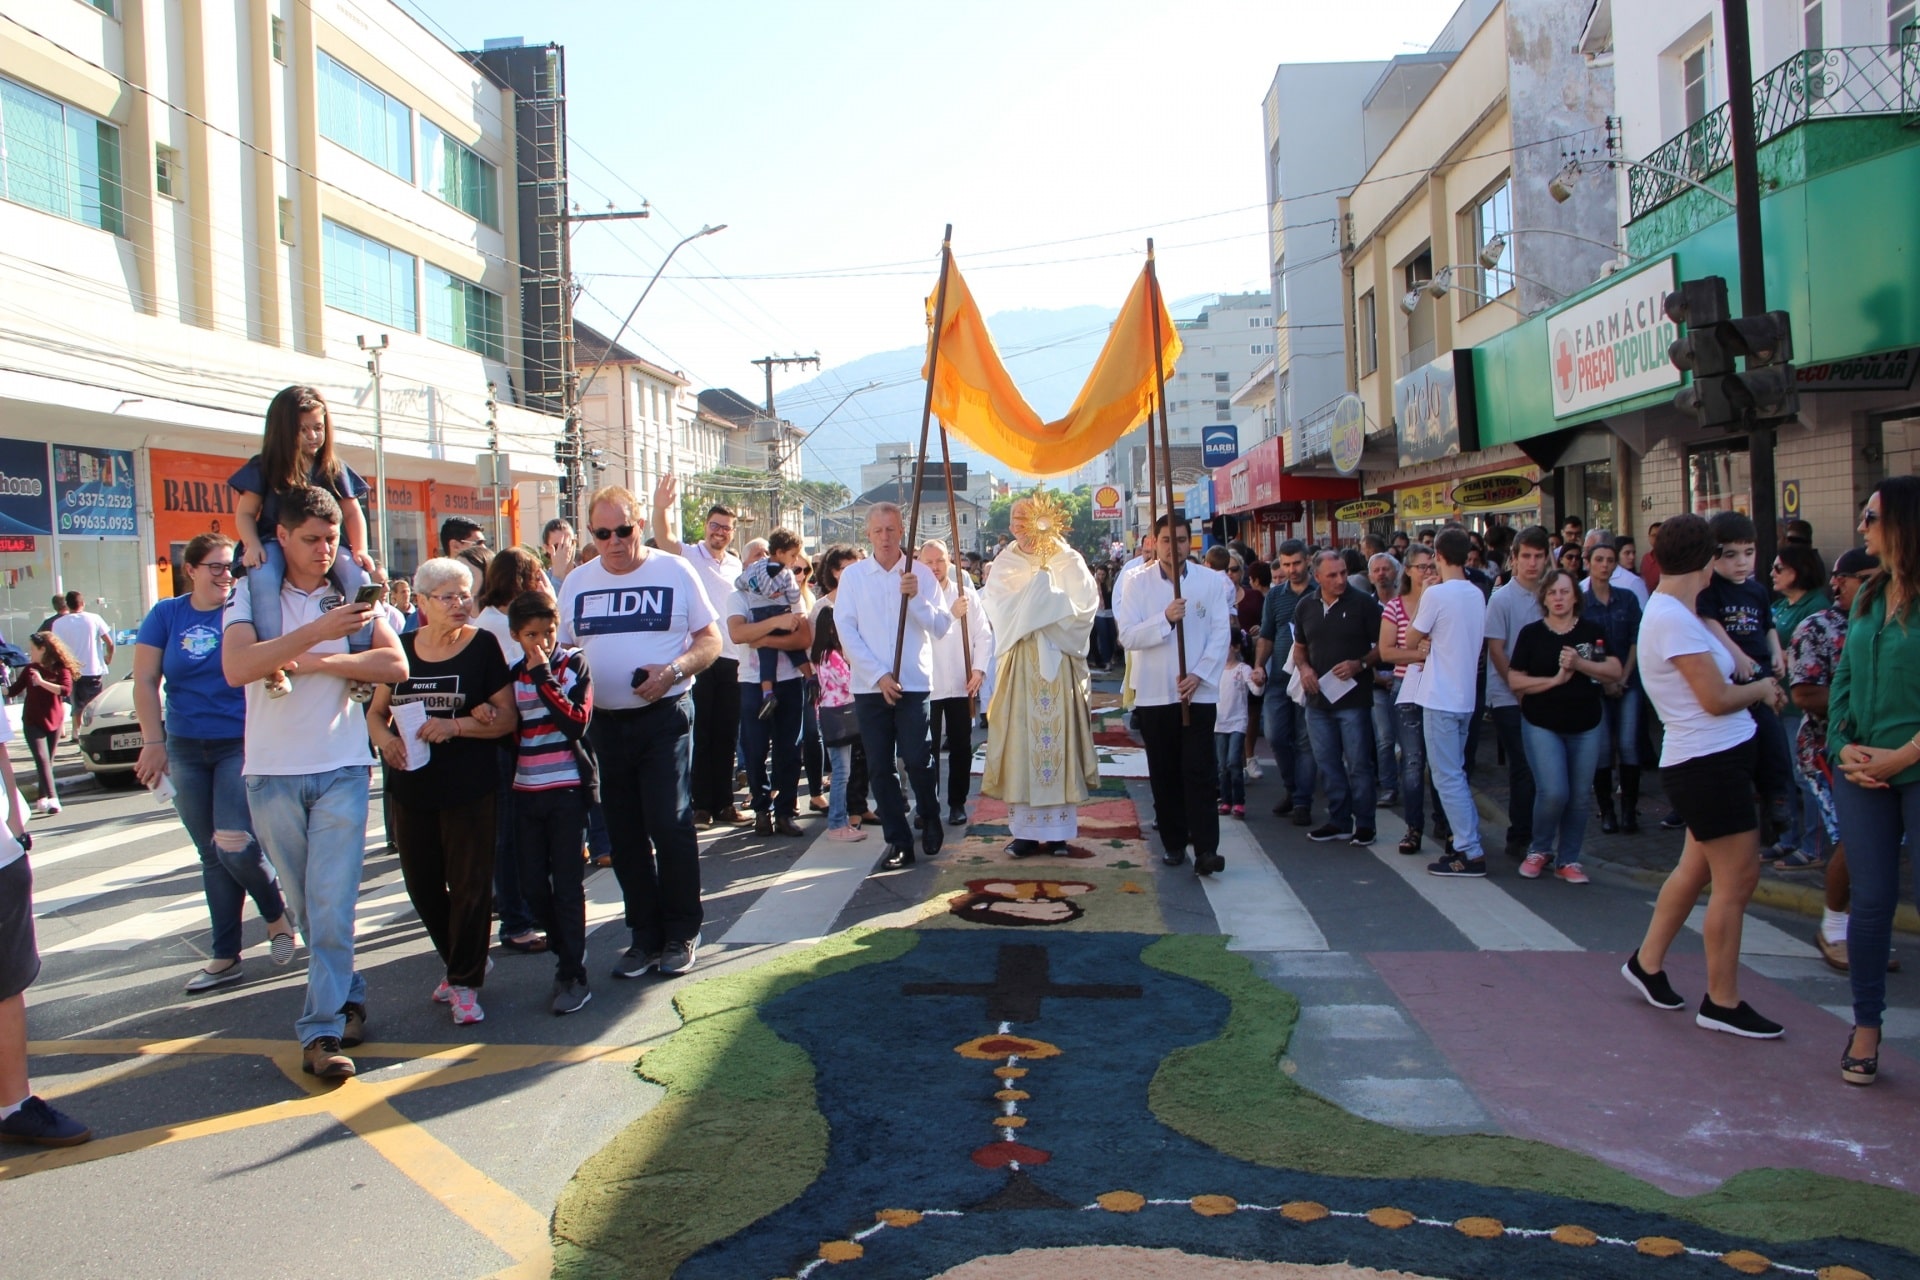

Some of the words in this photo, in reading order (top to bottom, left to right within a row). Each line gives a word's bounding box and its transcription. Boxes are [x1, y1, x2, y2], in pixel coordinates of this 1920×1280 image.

[1575, 290, 1668, 354] FARMÁCIA
[1205, 444, 1236, 452] BARBI
[1464, 482, 1481, 492] TEM
[1482, 480, 1494, 489] DE
[1496, 478, 1520, 487] TUDO
[78, 492, 133, 509] 3375.2523
[387, 484, 413, 506] toda
[445, 494, 451, 508] a
[453, 495, 468, 509] sua
[73, 514, 134, 530] 99635.0935
[607, 589, 664, 617] LDN
[416, 695, 462, 708] WORLD
[113, 738, 144, 748] MLR-97
